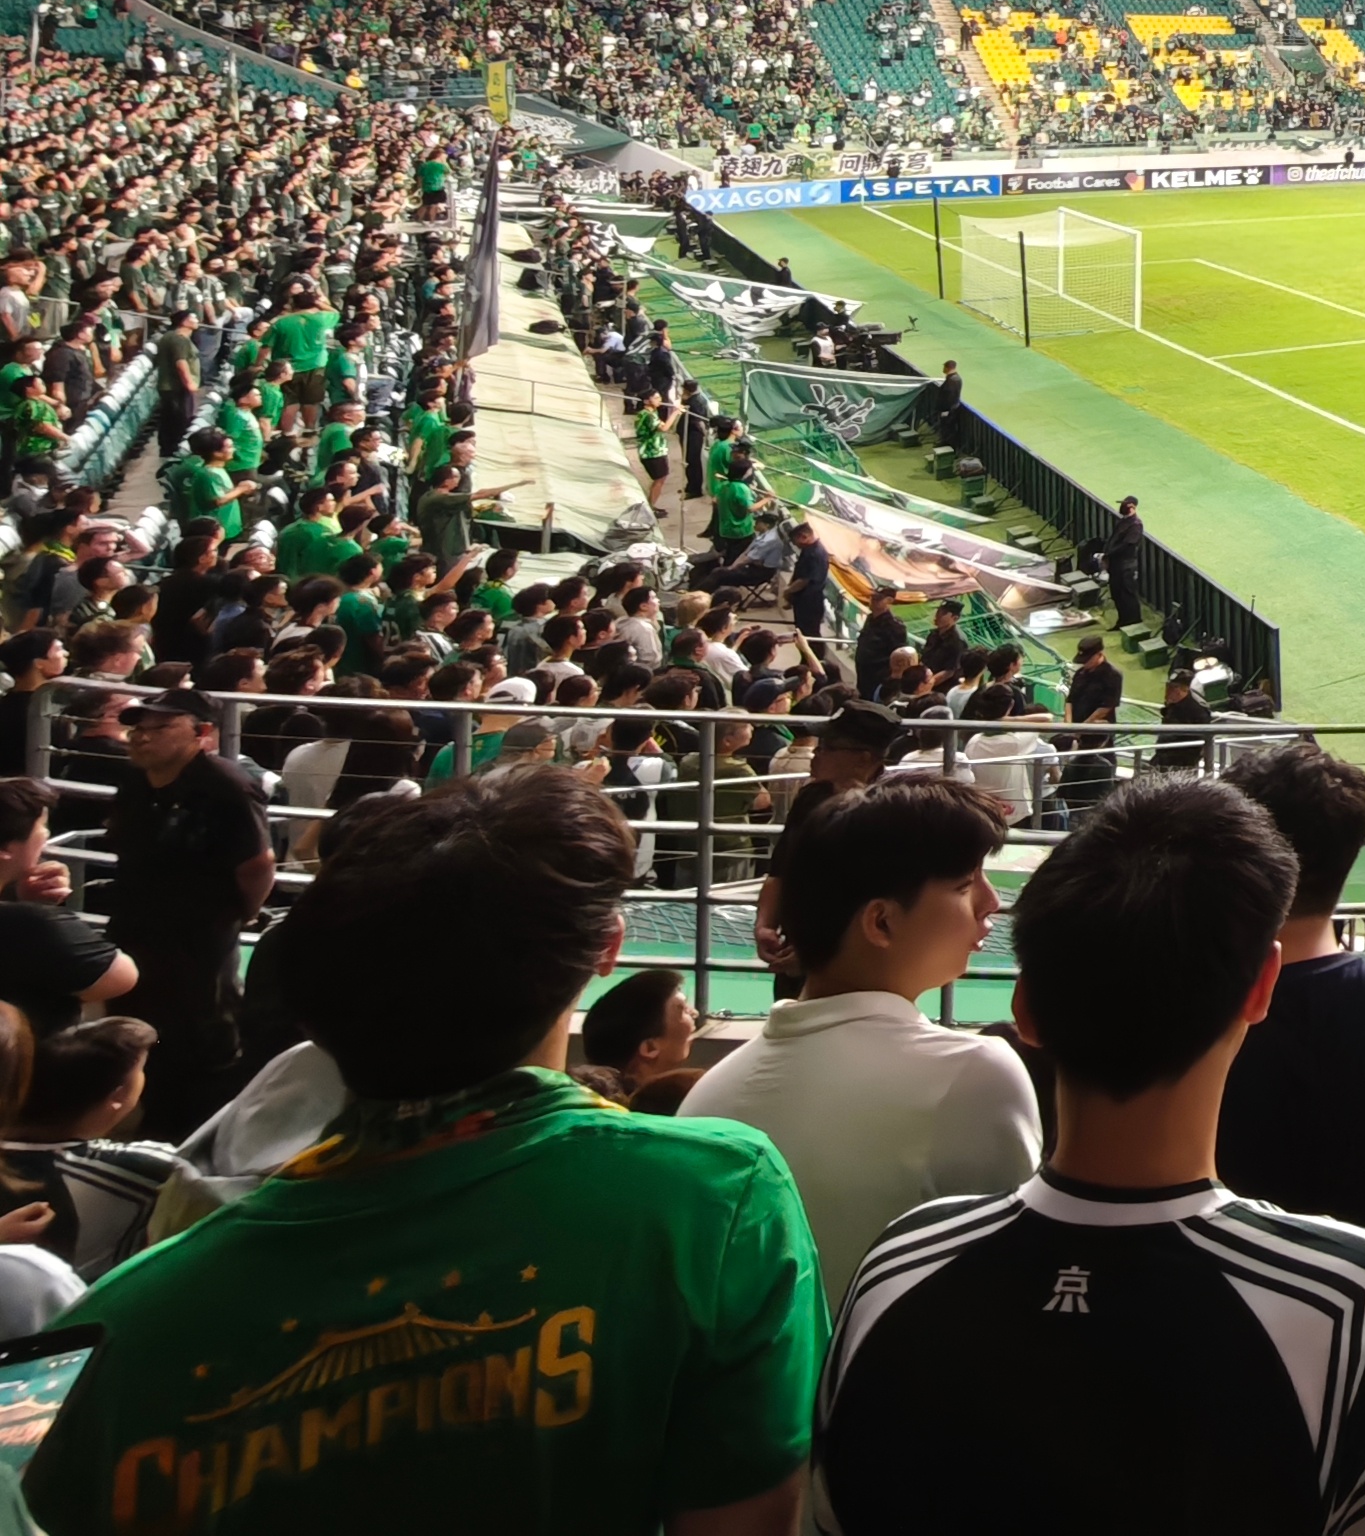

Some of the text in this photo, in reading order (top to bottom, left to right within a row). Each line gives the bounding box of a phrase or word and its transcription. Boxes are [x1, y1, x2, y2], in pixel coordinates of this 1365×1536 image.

[850, 178, 991, 198] ASPETAR
[1027, 175, 1121, 191] Football Cares
[1151, 168, 1242, 189] KELME
[687, 187, 802, 211] OXAGON
[112, 1305, 597, 1530] CHAMPIONS
